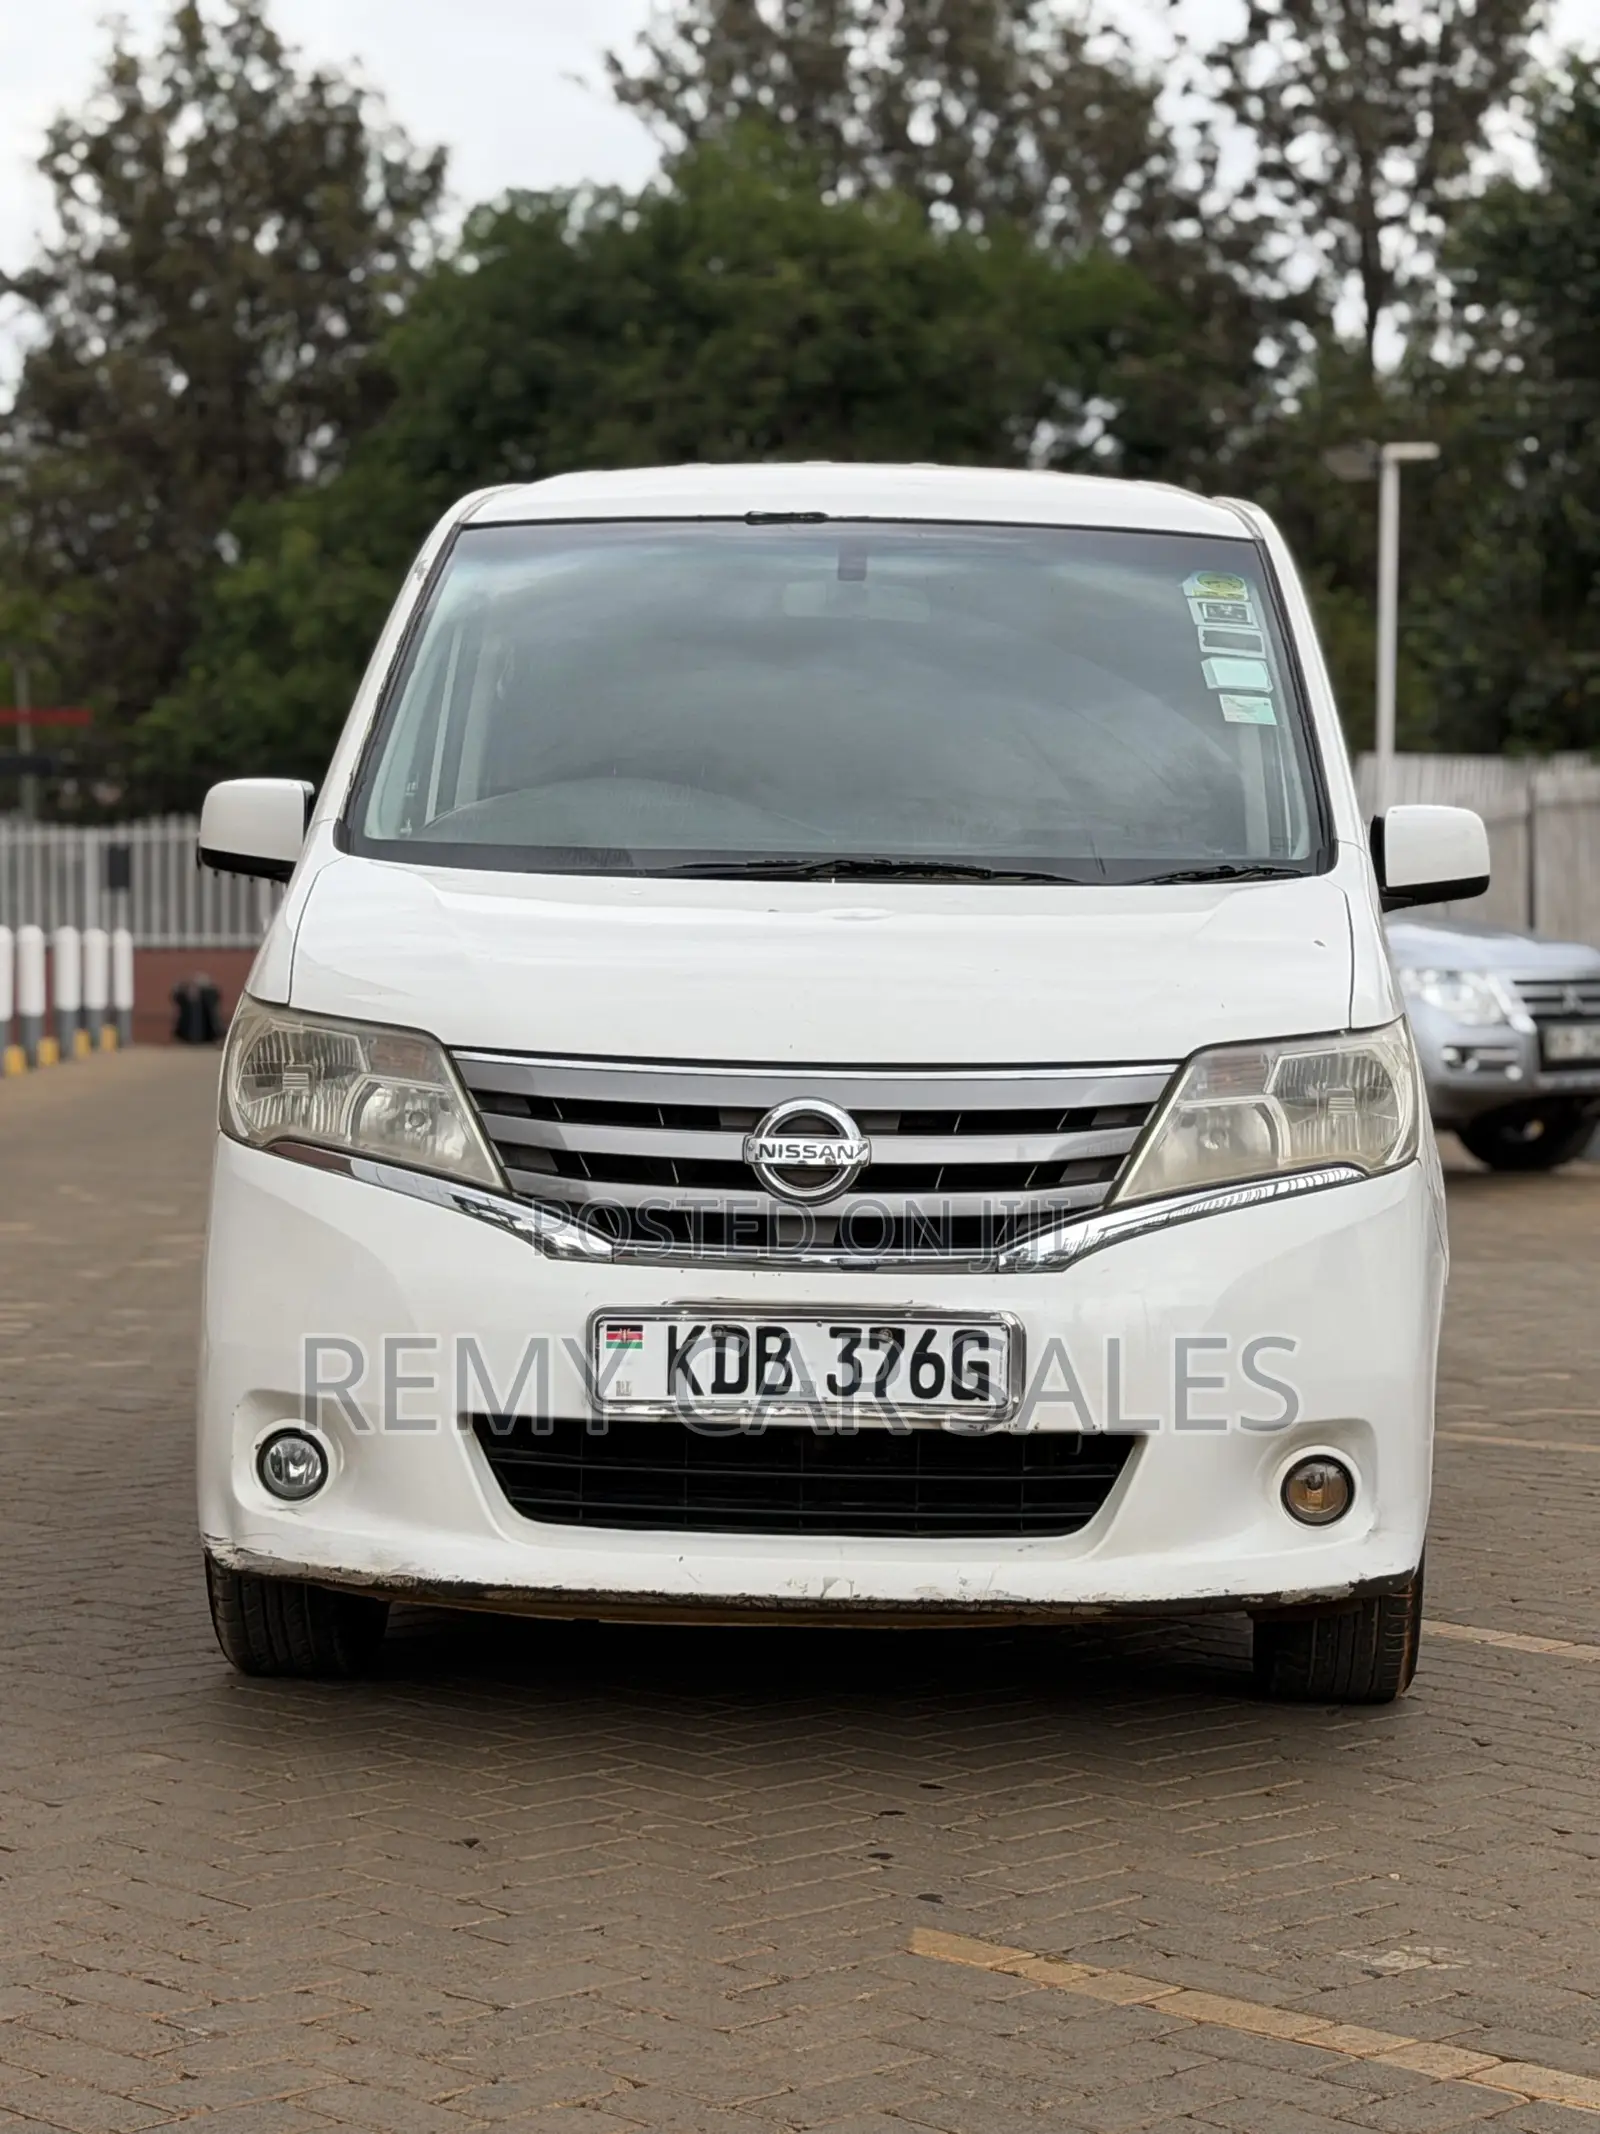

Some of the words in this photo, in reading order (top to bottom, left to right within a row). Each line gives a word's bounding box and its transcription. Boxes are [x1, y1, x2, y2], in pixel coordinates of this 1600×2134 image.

[758, 1141, 854, 1161] NISSAN
[667, 1325, 794, 1398] KDB
[826, 1326, 991, 1401] 376G
